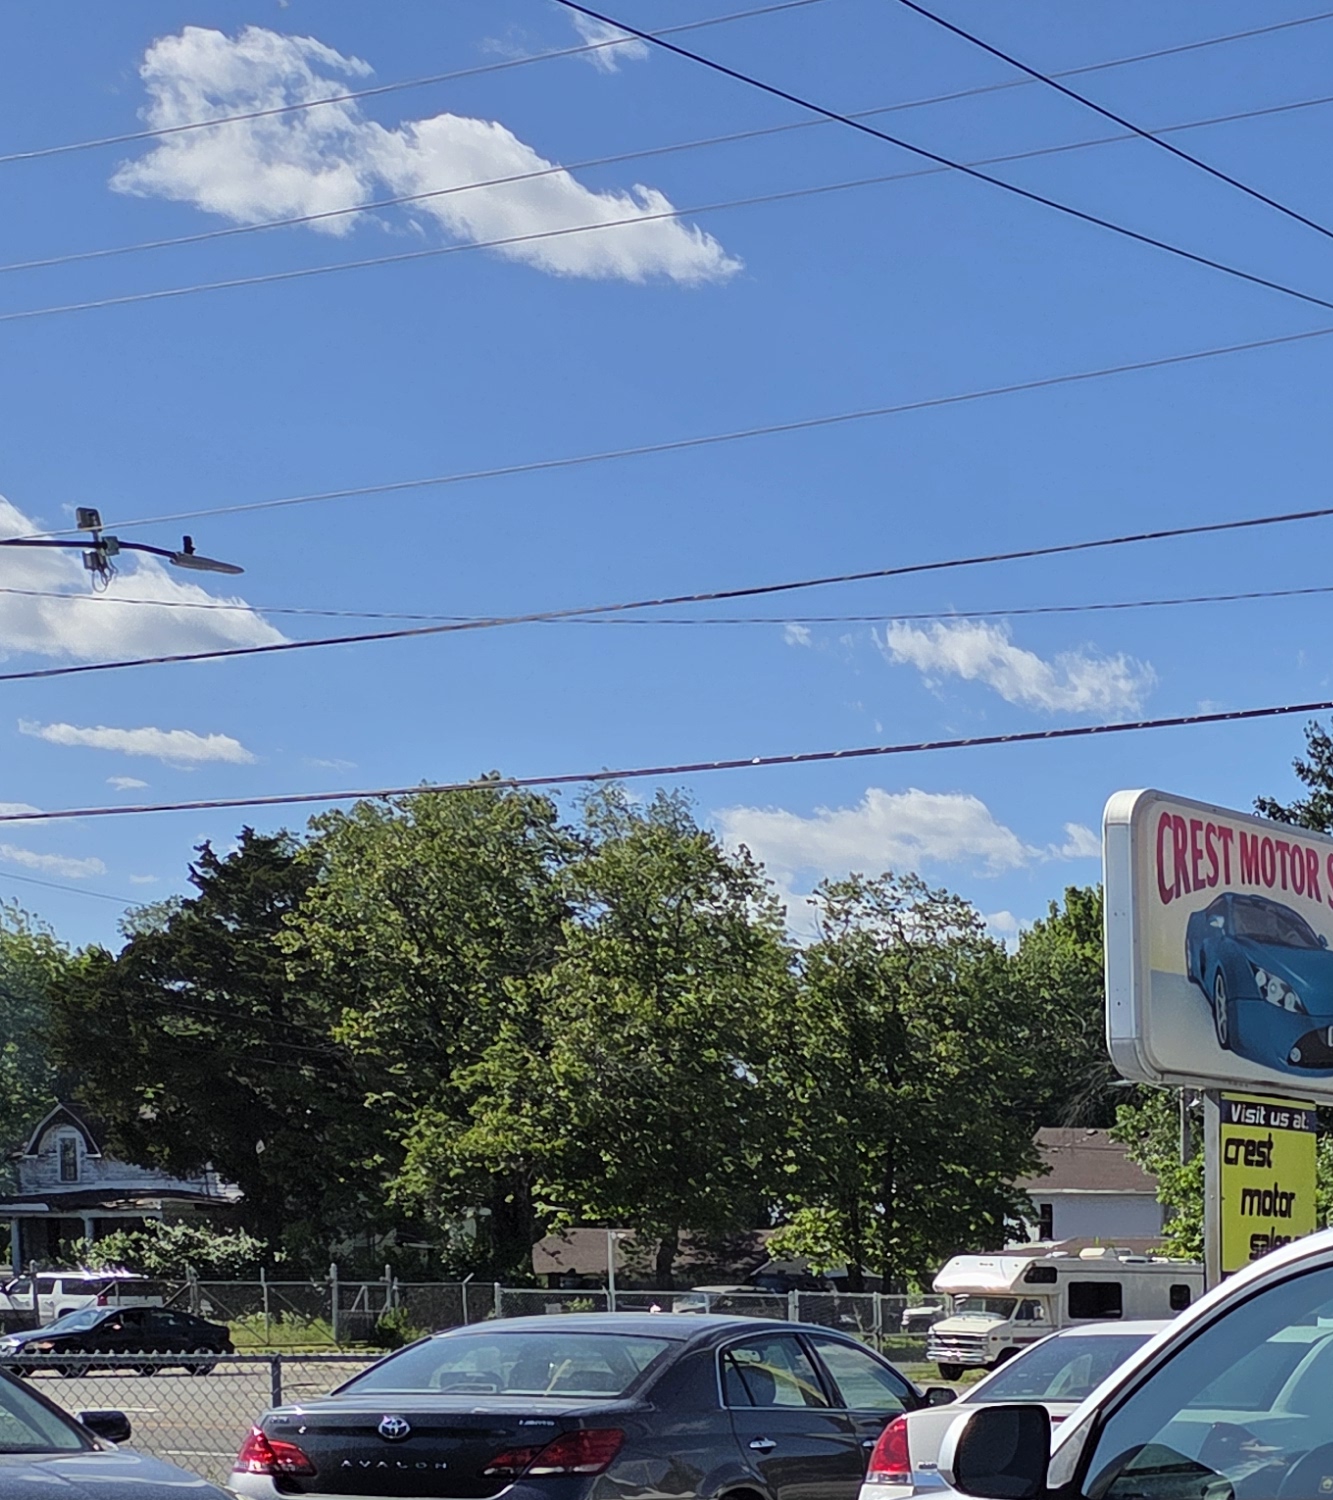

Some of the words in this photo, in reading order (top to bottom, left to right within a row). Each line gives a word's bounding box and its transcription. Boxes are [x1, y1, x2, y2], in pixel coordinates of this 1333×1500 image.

[1156, 811, 1233, 905] CREST
[1239, 831, 1322, 902] MOTOR
[1231, 1103, 1266, 1125] Visit
[1270, 1111, 1290, 1127] us
[1224, 1132, 1274, 1168] crest
[1240, 1182, 1296, 1218] motor
[1249, 1226, 1291, 1261] sal
[340, 1459, 448, 1469] AVALON
